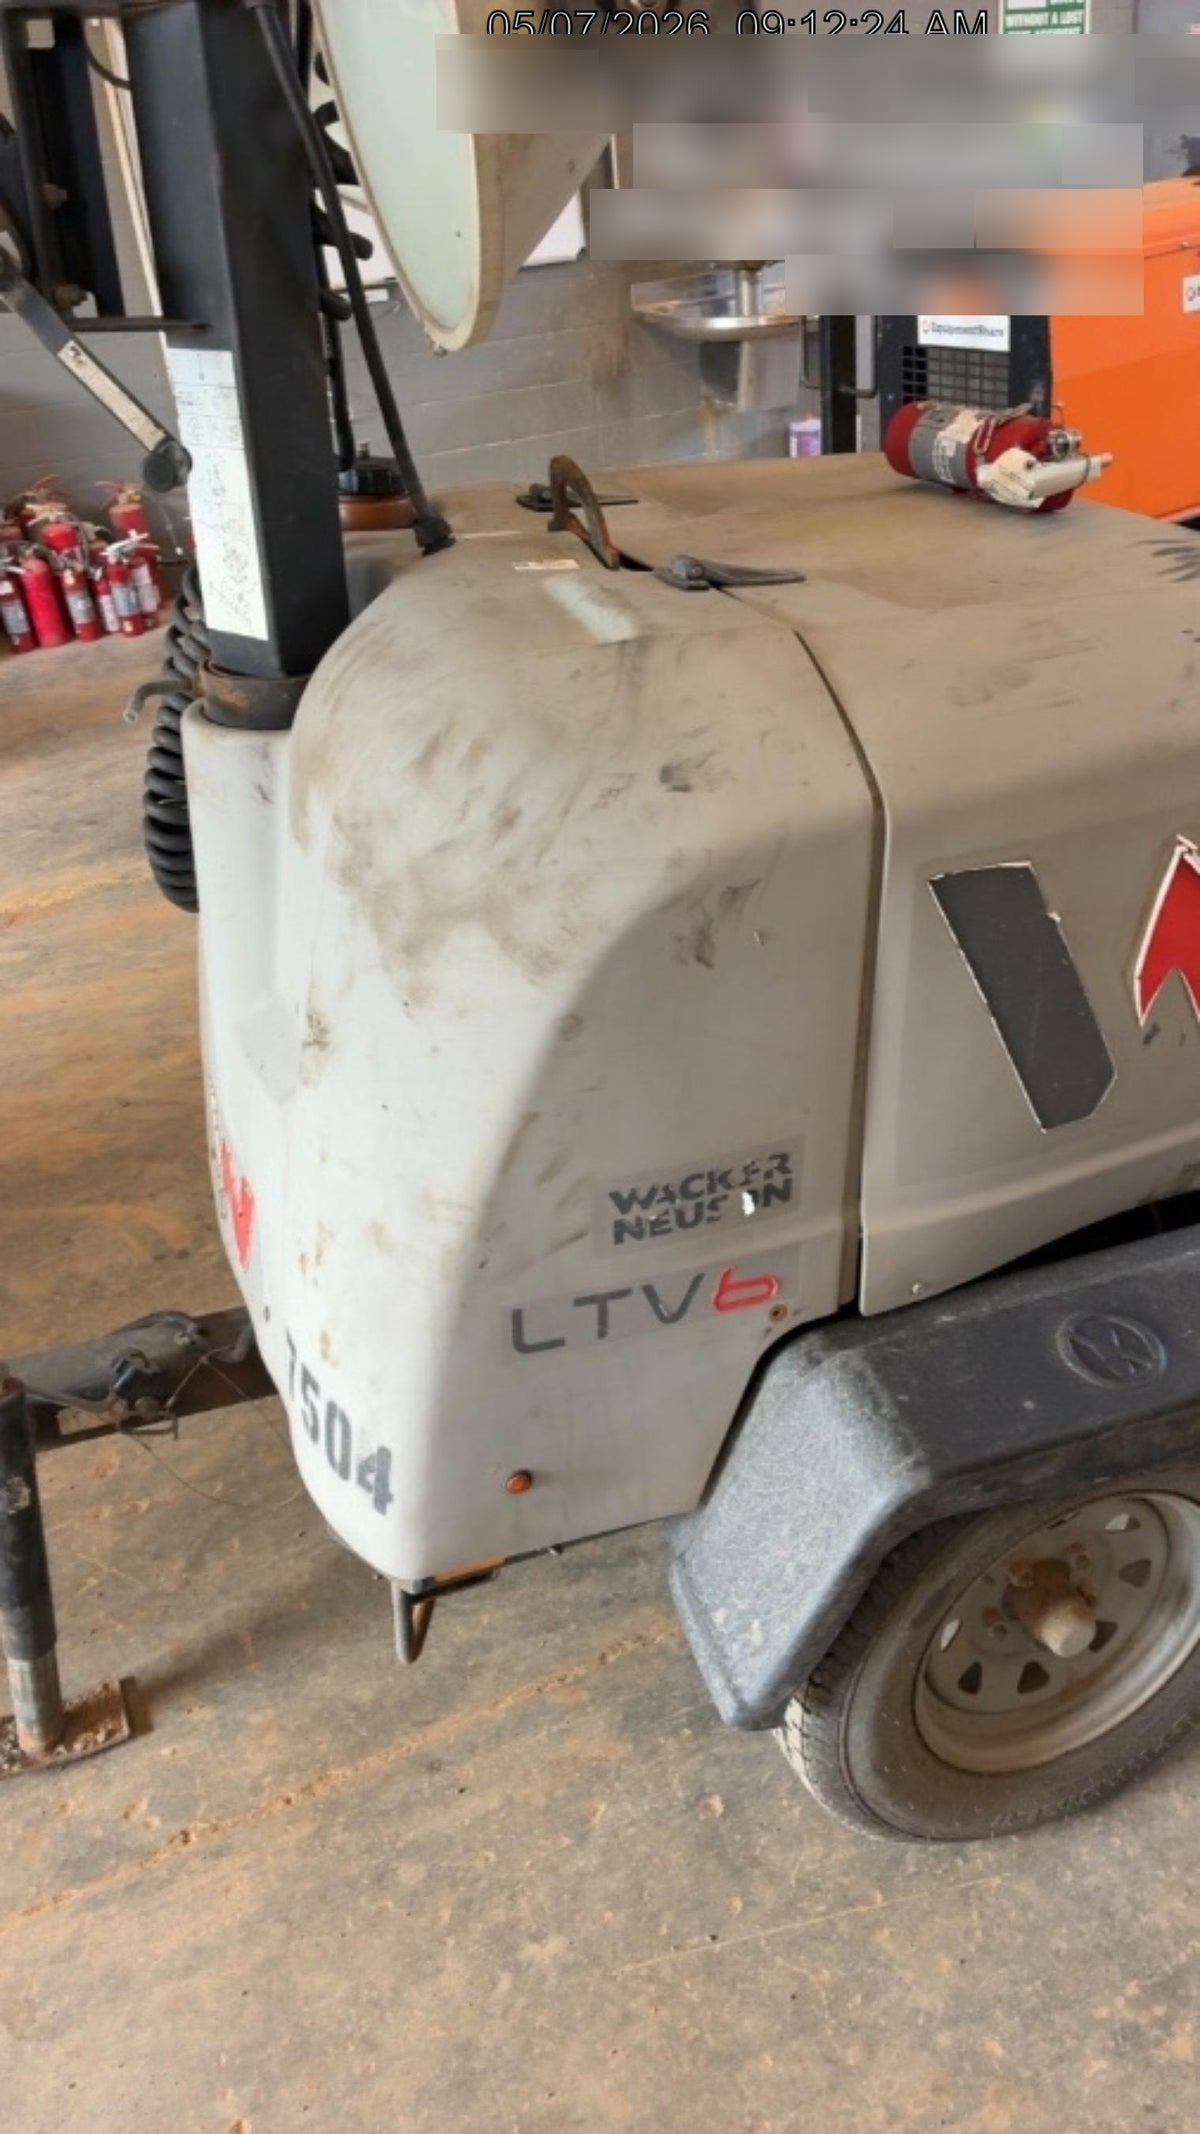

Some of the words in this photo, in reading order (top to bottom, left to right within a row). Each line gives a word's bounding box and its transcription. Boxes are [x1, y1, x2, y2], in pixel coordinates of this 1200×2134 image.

[609, 1152, 793, 1214] WACKER
[511, 1265, 779, 1354] LTV6
[286, 1327, 394, 1516] 7504
